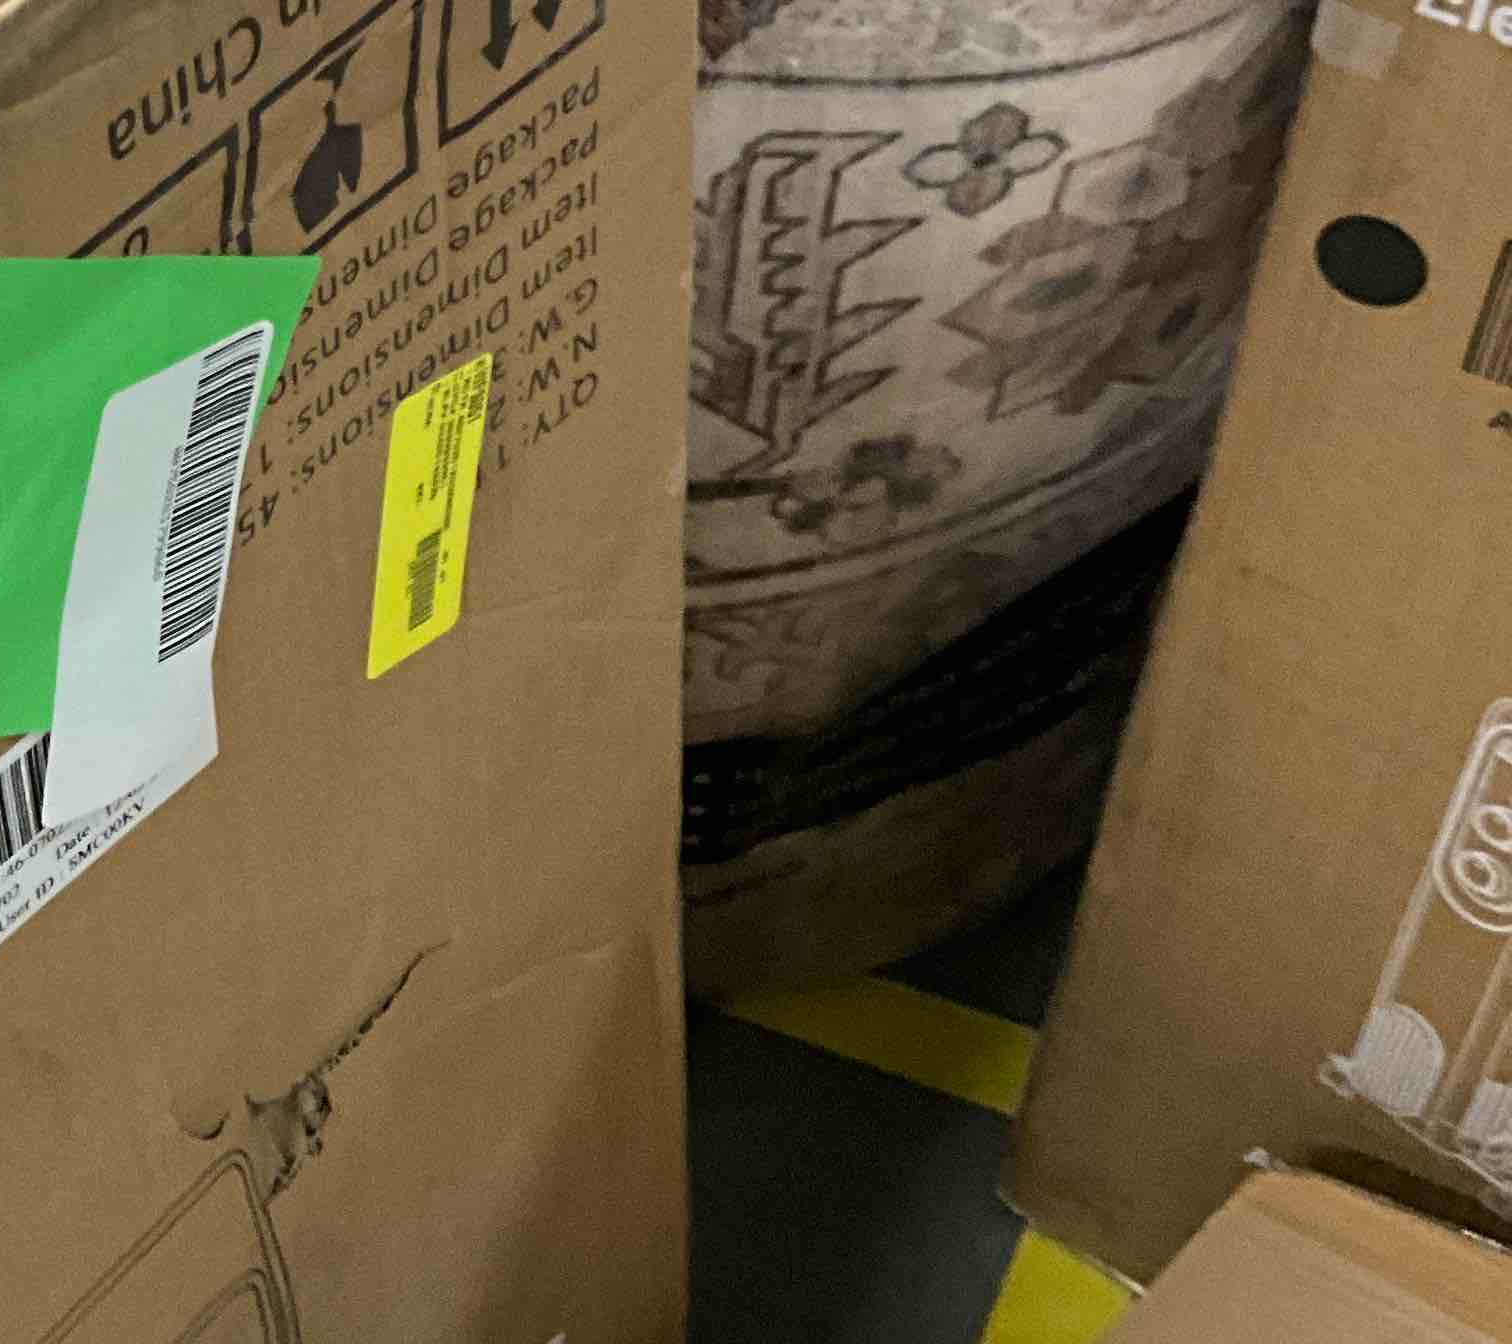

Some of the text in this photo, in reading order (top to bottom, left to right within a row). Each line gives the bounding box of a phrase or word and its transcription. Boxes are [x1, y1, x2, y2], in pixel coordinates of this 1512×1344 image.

[107, 16, 262, 161] China
[446, 64, 600, 200] Package
[447, 121, 598, 254] Package
[521, 171, 598, 254] Item
[521, 226, 598, 299] Item
[287, 246, 510, 446] Dimensions:
[289, 295, 510, 494] Dimensions:
[522, 370, 599, 448] QTY:
[34, 876, 55, 901] ID
